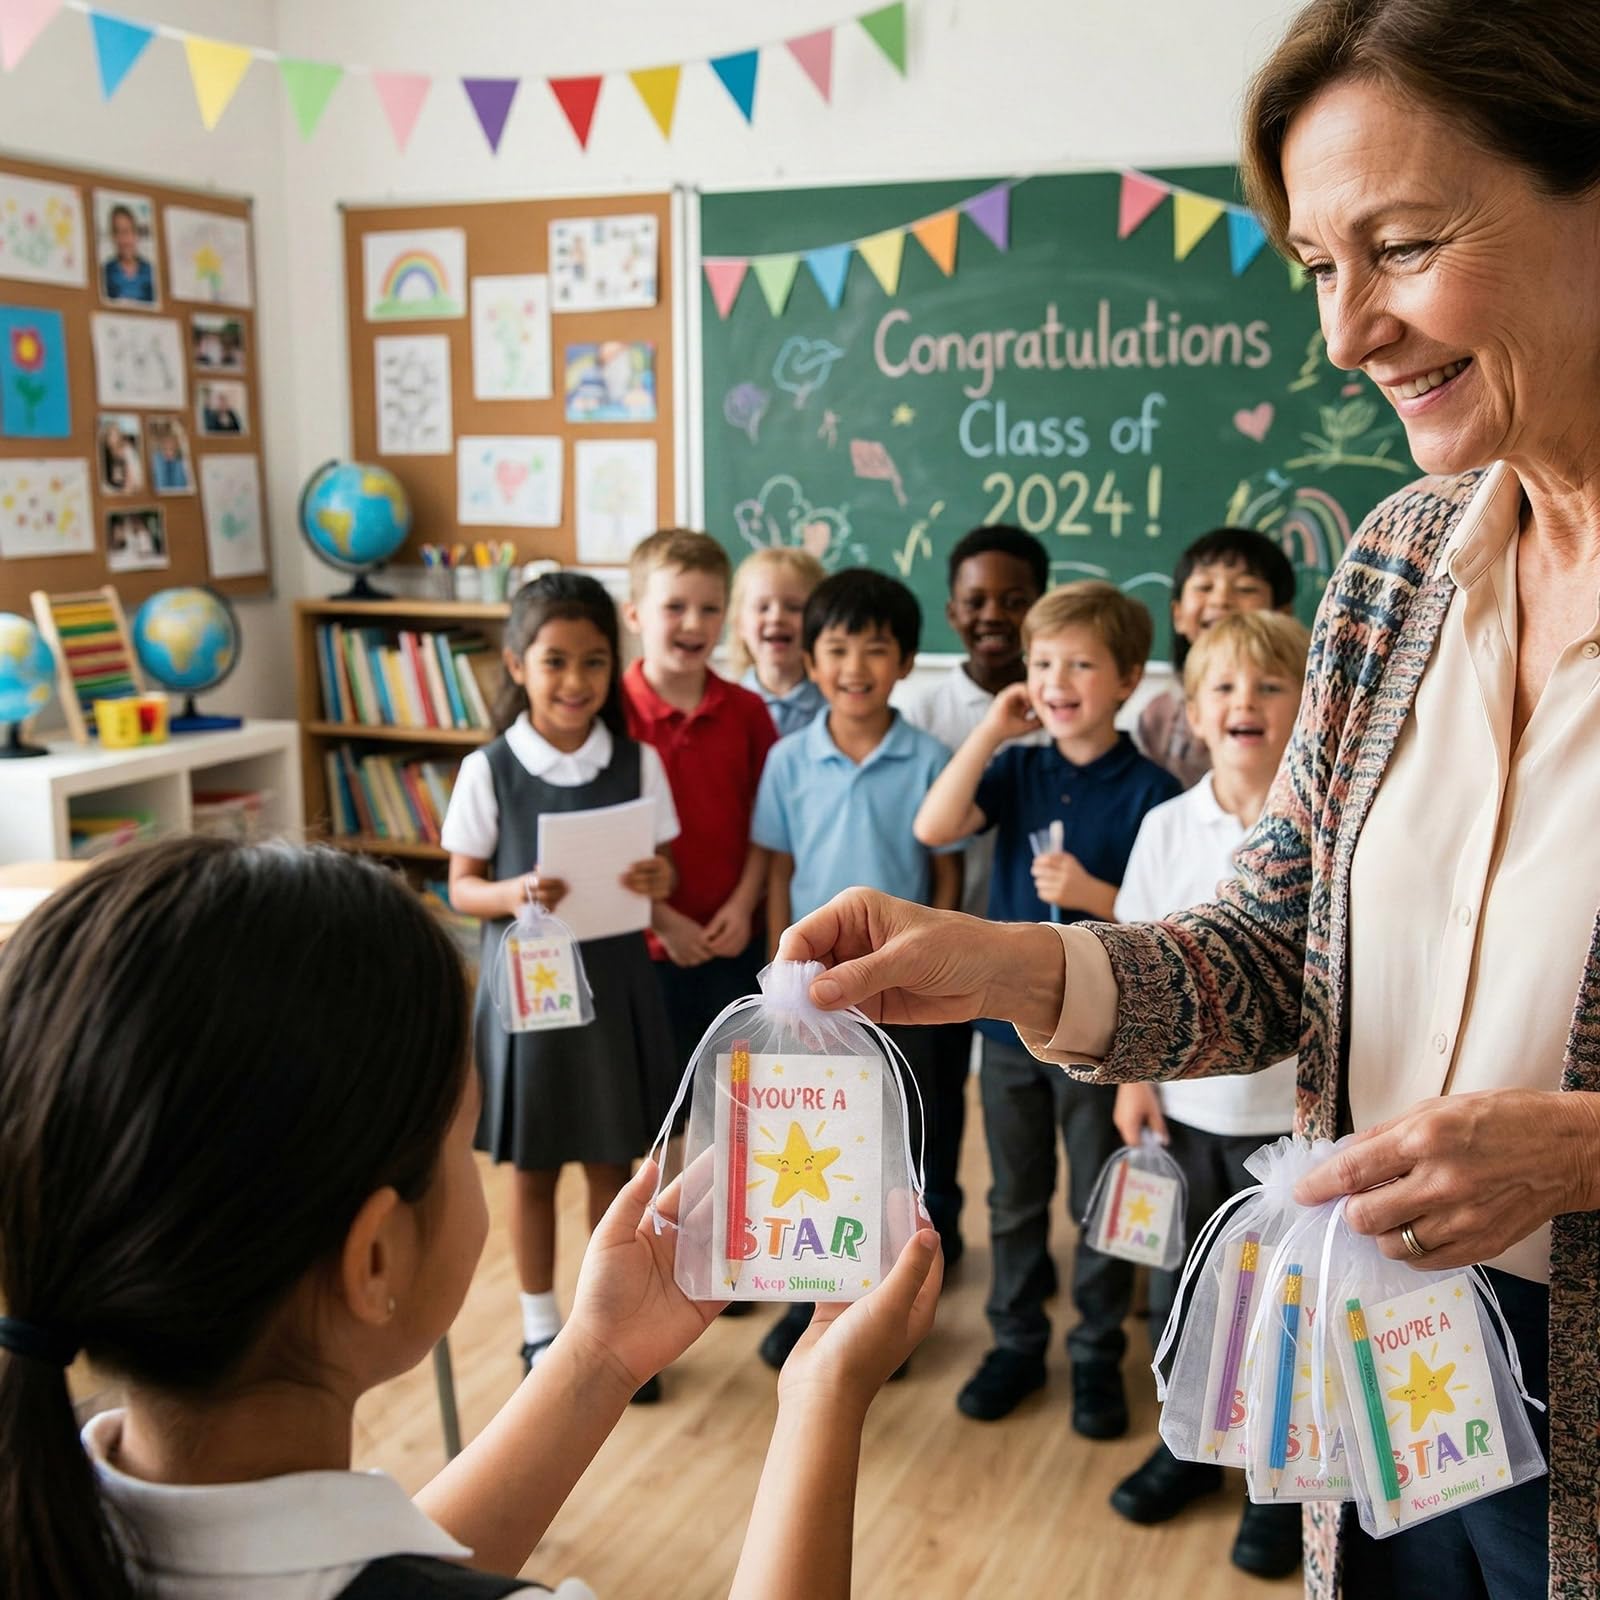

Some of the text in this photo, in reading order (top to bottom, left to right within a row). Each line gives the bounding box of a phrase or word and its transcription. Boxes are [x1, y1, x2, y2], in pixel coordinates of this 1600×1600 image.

[873, 299, 1273, 399] Congratulations
[958, 391, 1167, 459] Class of
[751, 1087, 847, 1110] YOU'RE A
[752, 1276, 785, 1292] Keep
[1374, 1312, 1451, 1354] YOU'RE A
[1286, 1423, 1345, 1463] STA
[1411, 1492, 1440, 1510] Keep
